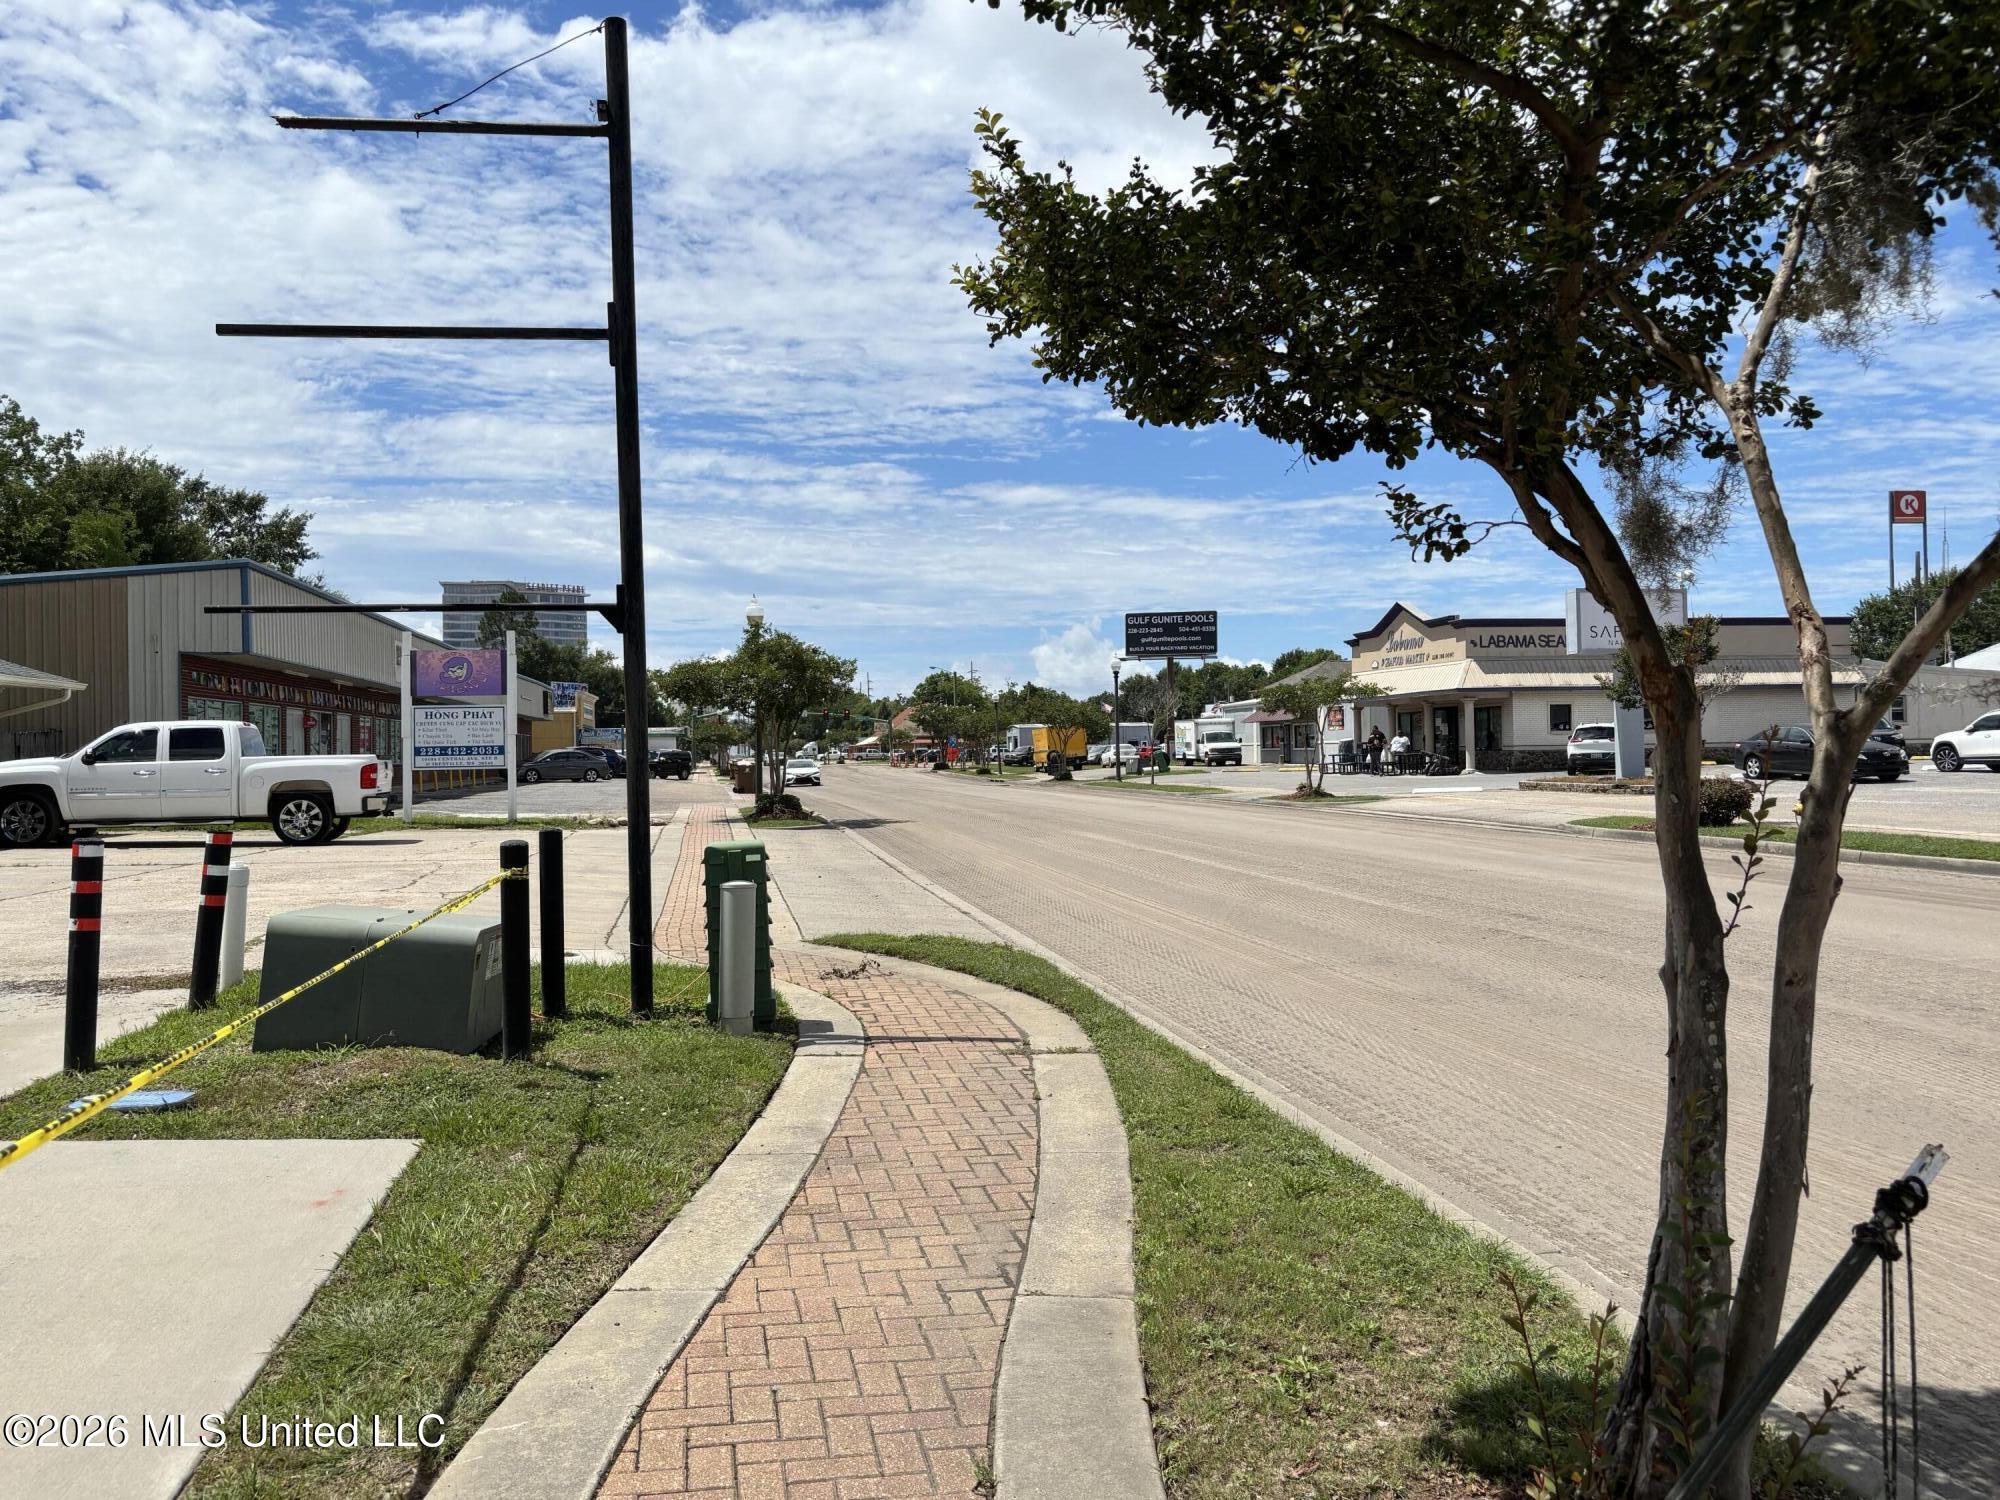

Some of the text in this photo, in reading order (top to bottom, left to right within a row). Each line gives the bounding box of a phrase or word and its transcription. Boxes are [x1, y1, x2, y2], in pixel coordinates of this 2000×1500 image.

[1127, 614, 1214, 625] GULF GUNITE POOLS
[1141, 635, 1202, 643] gulfgunitepools.com
[1479, 634, 1536, 649] LABAMA
[419, 746, 500, 756] 228-432-2035
